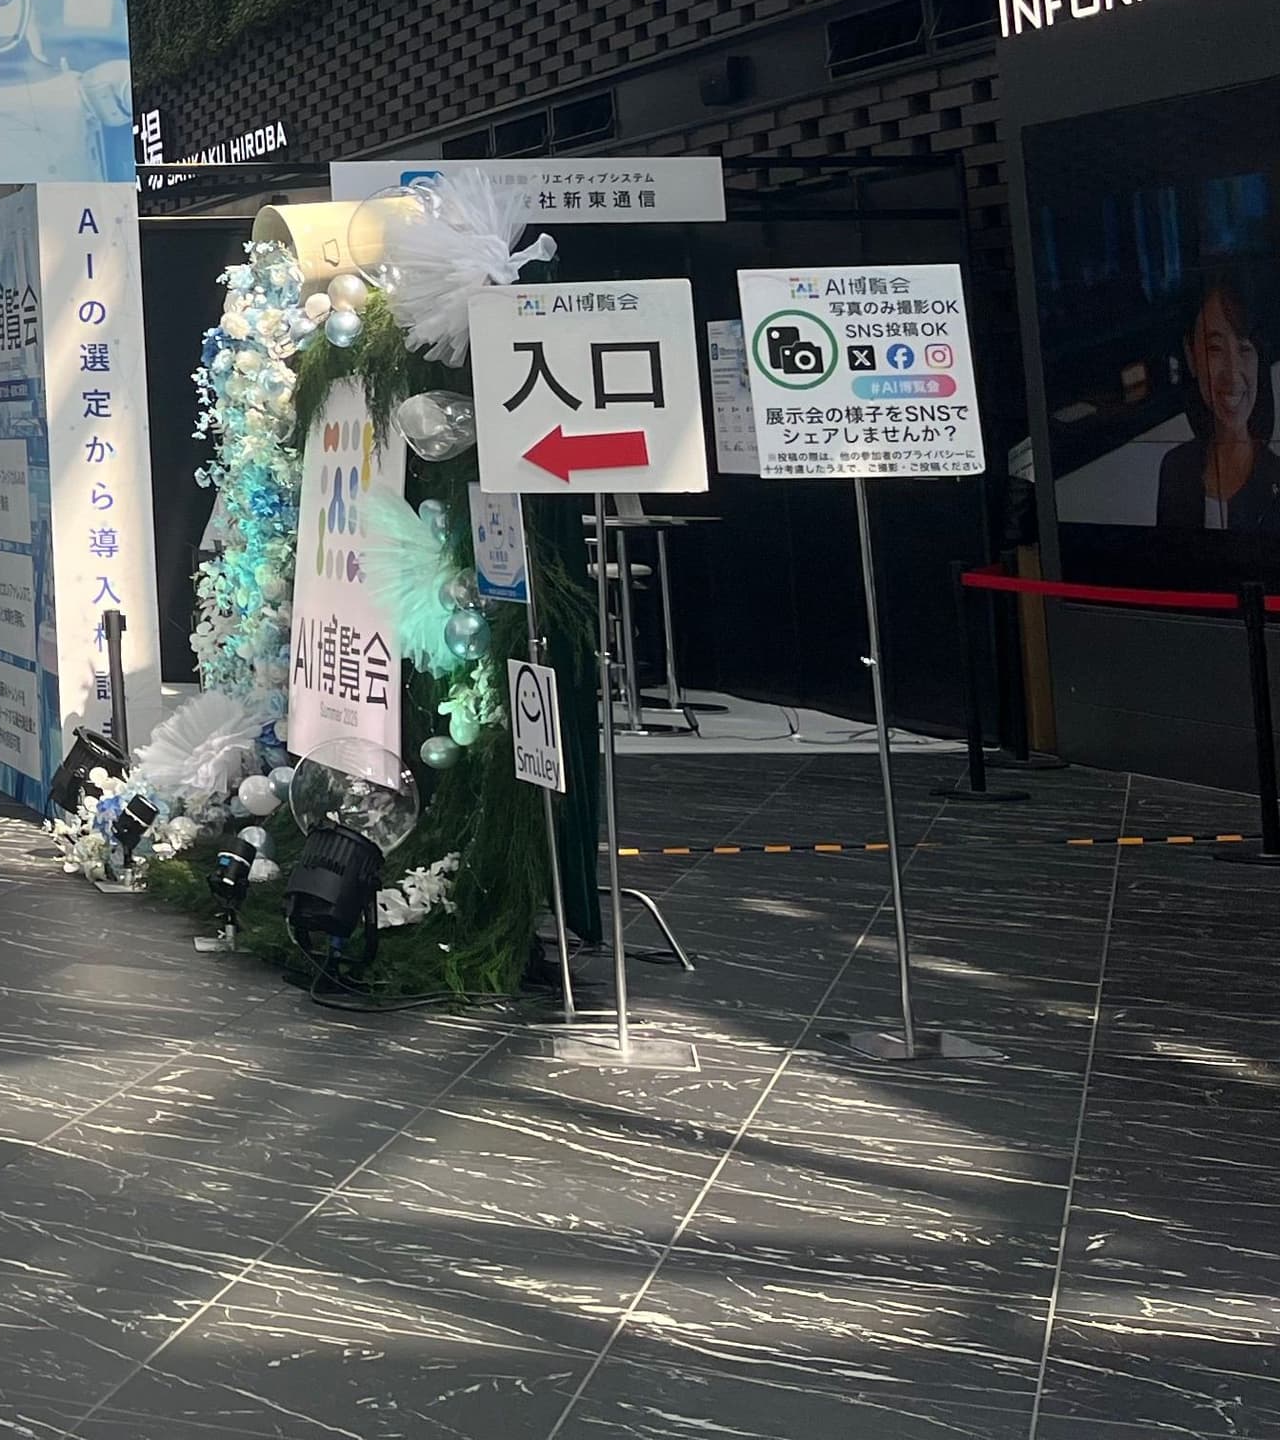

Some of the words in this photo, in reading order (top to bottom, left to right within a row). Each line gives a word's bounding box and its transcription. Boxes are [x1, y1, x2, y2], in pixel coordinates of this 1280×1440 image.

[230, 120, 287, 164] HIROBA
[825, 276, 911, 296] AI博覧会
[552, 292, 639, 313] AI博覧会
[830, 300, 960, 317] 写真のみ撮影OK
[845, 322, 948, 338] SNS投稿OK
[502, 341, 665, 412] 入口
[766, 405, 969, 425] 展示会の様子をSNSで
[783, 425, 957, 444] シェアしませんか？
[293, 614, 391, 710] AI博覧会
[517, 746, 559, 790] Smiley
